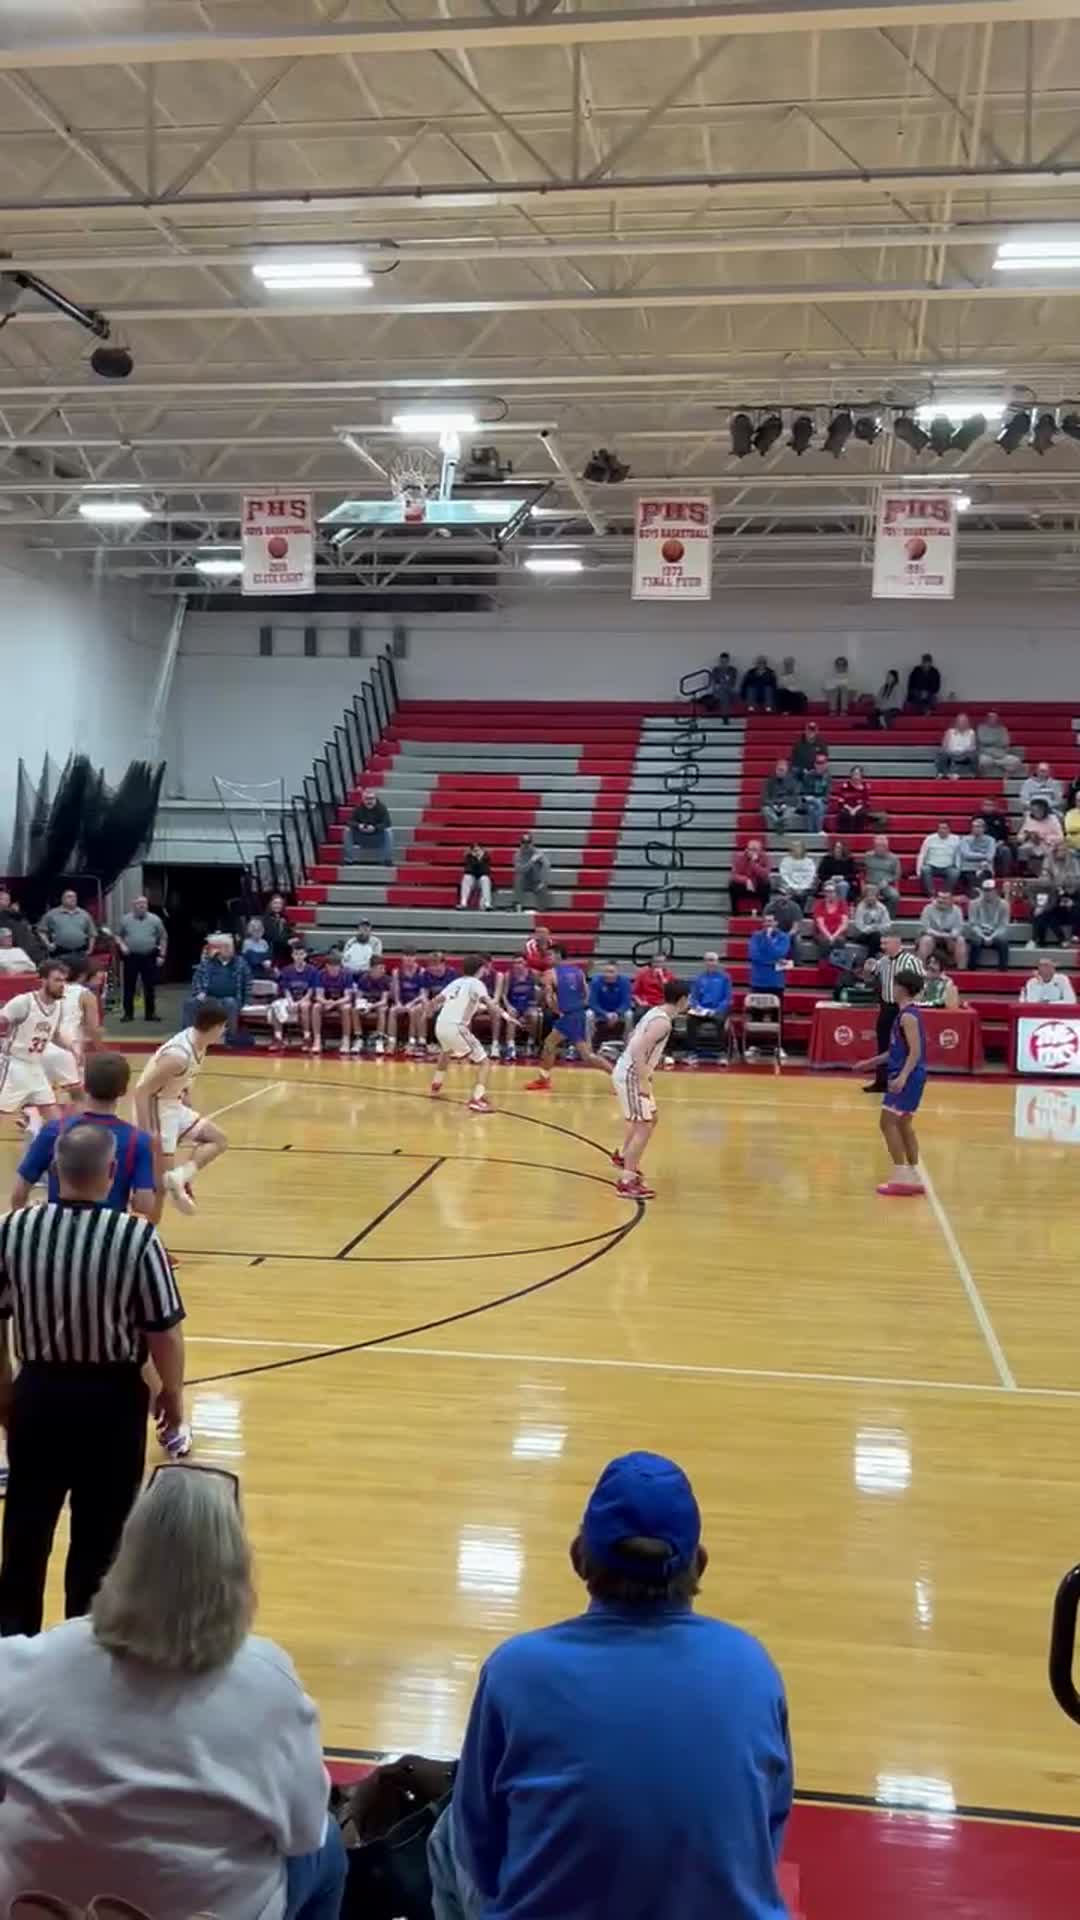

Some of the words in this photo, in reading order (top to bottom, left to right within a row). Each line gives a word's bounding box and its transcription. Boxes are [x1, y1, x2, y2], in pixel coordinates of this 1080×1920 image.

[247, 500, 306, 521] PHS
[640, 502, 708, 527] PHS
[884, 500, 949, 524] PHS
[640, 528, 658, 538] BOYS
[661, 528, 708, 538] BASKETBALL
